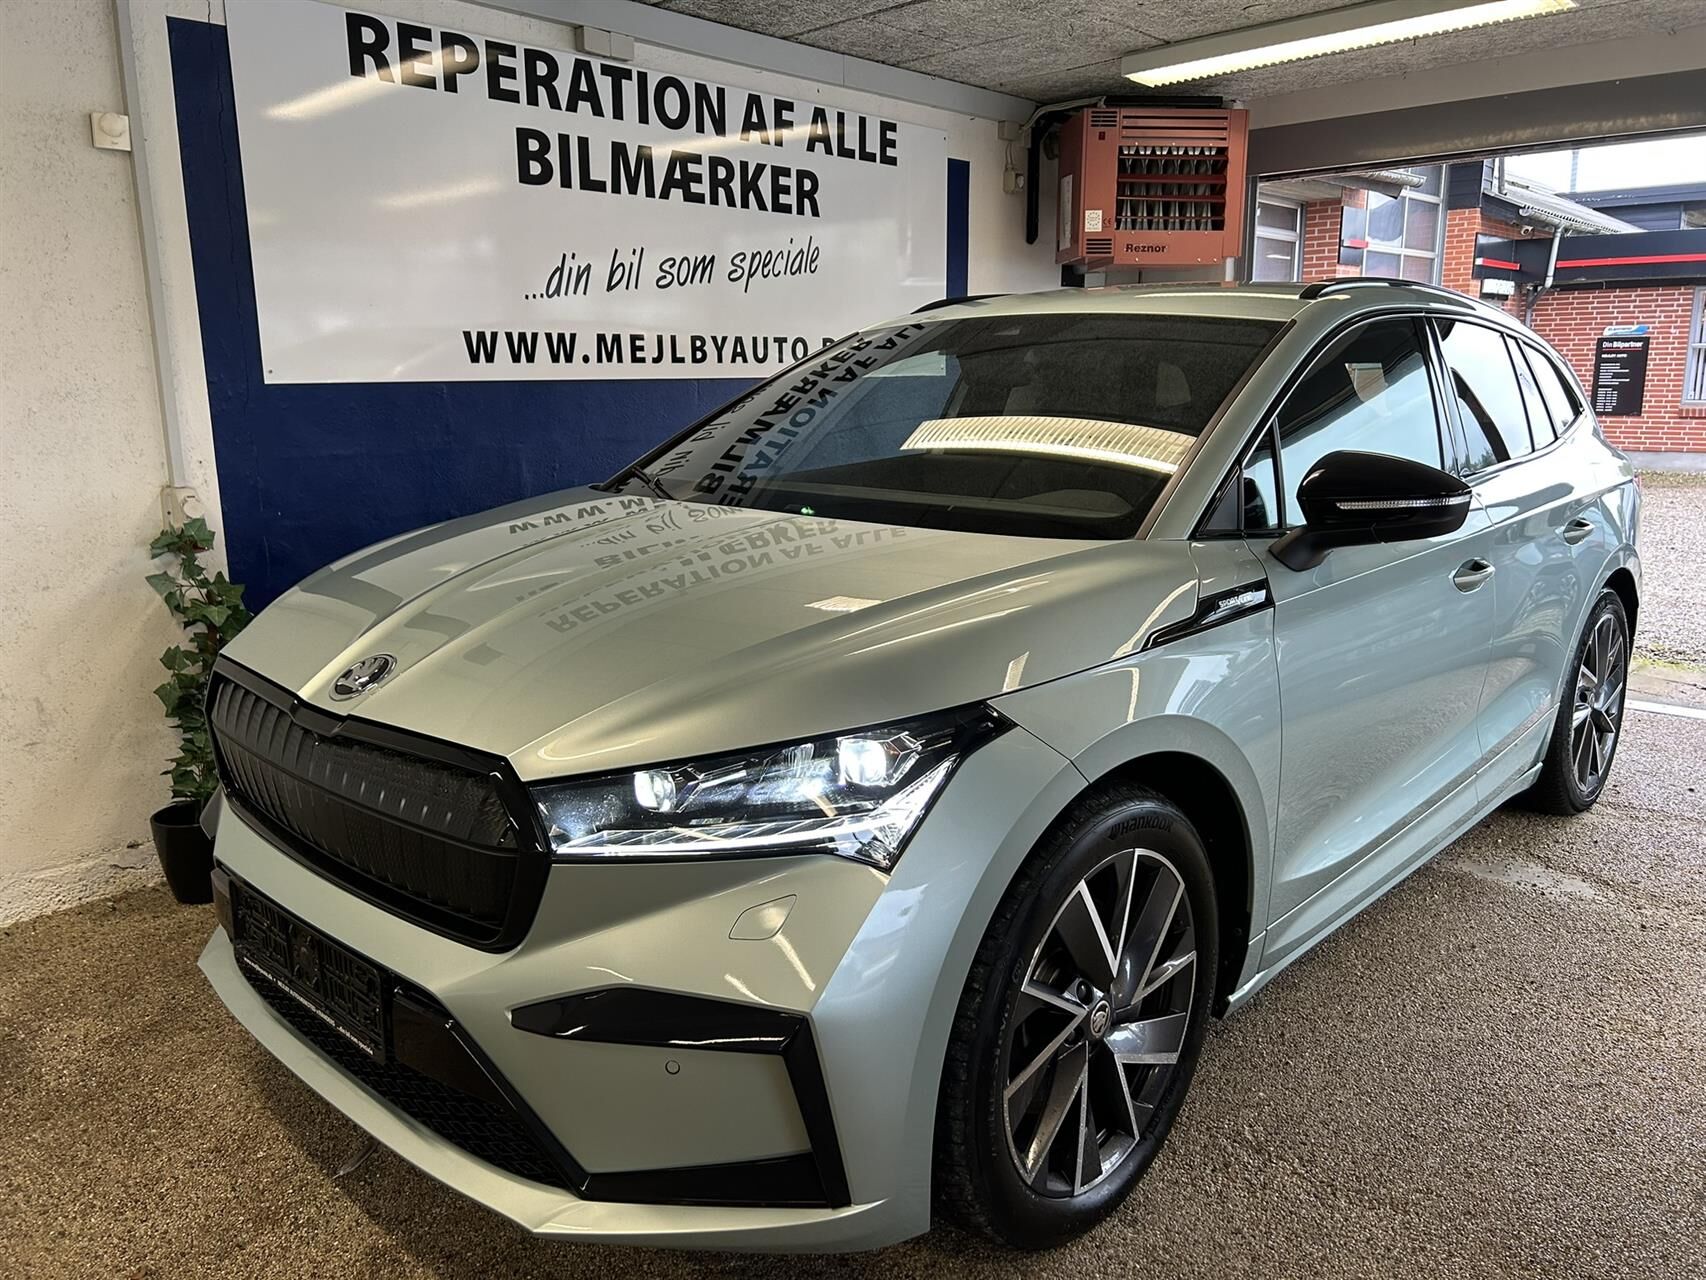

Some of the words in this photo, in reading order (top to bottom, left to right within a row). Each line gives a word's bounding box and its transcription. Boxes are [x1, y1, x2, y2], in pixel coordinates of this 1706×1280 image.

[346, 12, 726, 137] REPERATION
[739, 92, 795, 148] AF
[806, 106, 898, 167] ALLE
[516, 128, 821, 219] BILMÆRKER
[525, 252, 592, 300] ...din
[606, 246, 644, 293] bil
[655, 254, 715, 290] som
[727, 235, 820, 294] speciale
[1125, 243, 1167, 253] Reznor
[463, 330, 838, 365] WWW.MEJLBYAUTO
